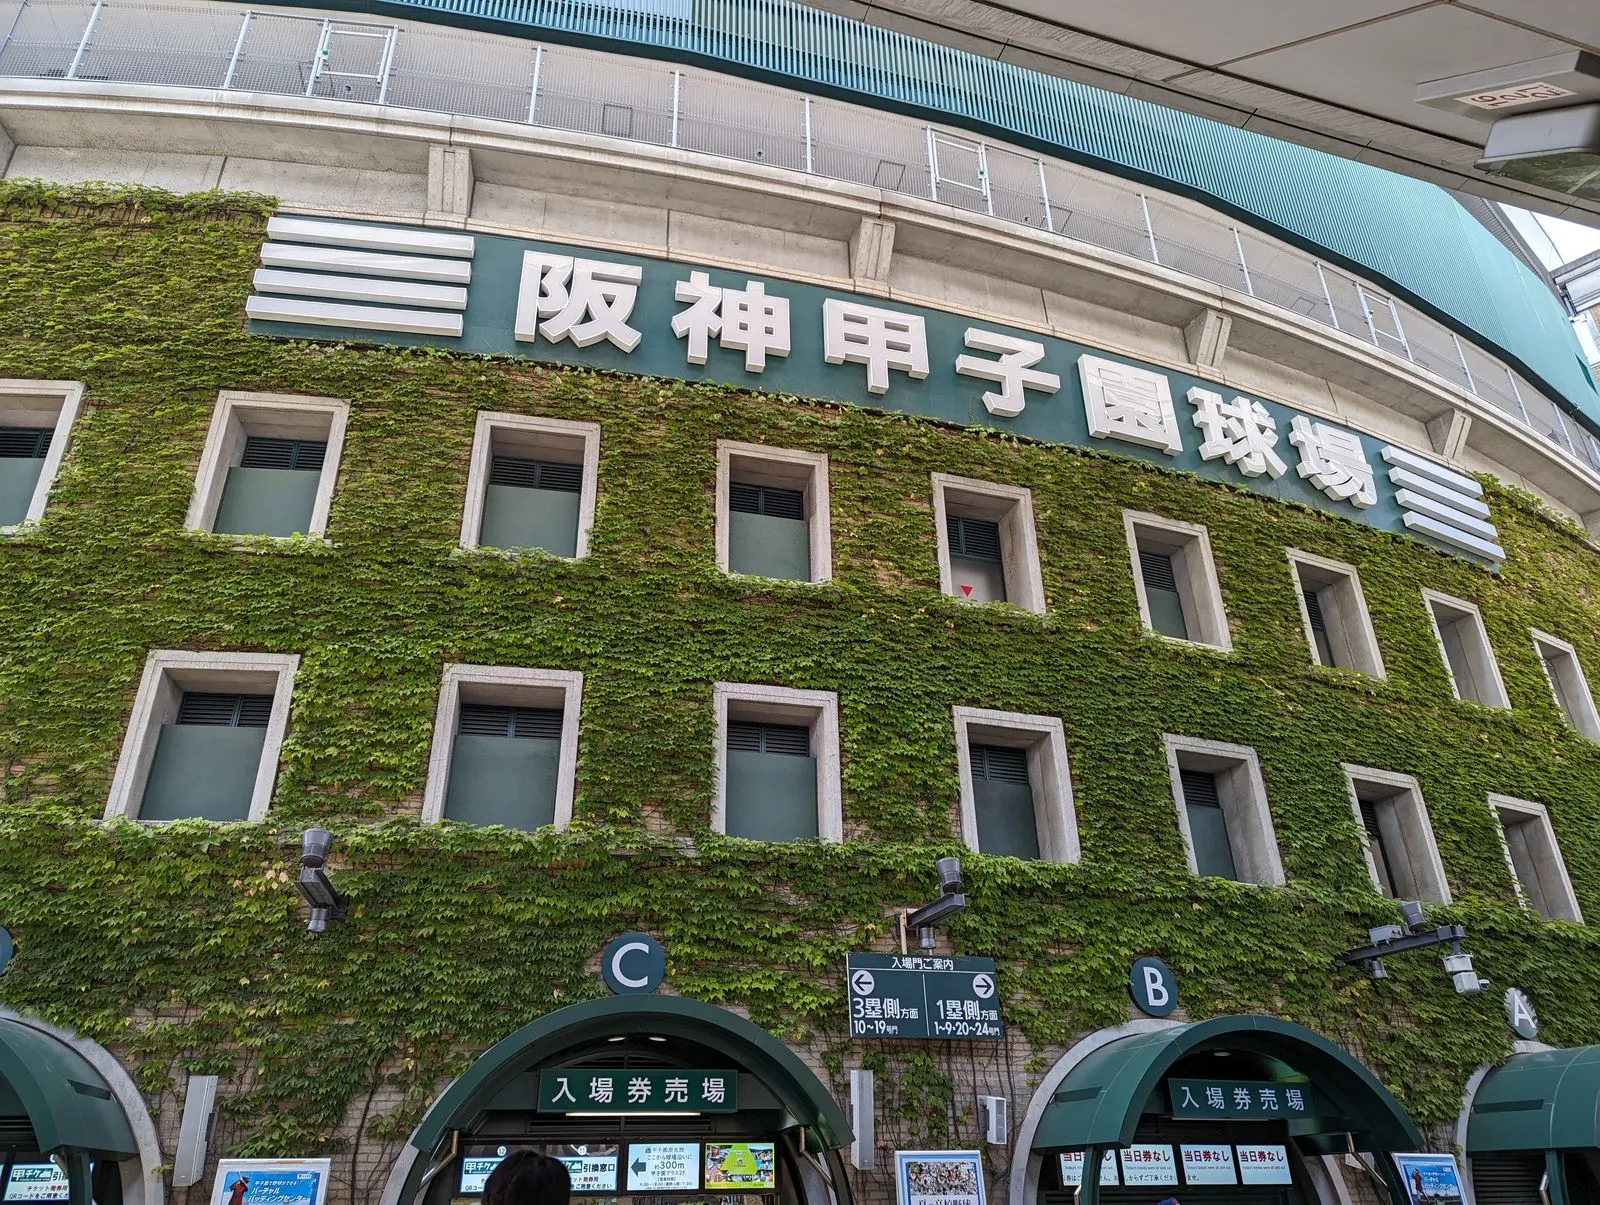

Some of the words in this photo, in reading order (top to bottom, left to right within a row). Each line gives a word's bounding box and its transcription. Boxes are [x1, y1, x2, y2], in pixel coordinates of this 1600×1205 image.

[514, 250, 1377, 510] 阪神甲子園球場
[611, 942, 650, 988] C
[891, 956, 954, 971] 入場門ご案内
[1143, 966, 1169, 1007] B
[1514, 992, 1537, 1029] A
[551, 1076, 726, 1104] 入場券売場
[1181, 1086, 1305, 1111] 入場券売場
[1123, 1150, 1171, 1162] 当日券なし
[1184, 1150, 1230, 1162] 当日券なし
[1239, 1150, 1284, 1162] 当日券なし
[583, 1163, 615, 1173] 引換窓口
[250, 1186, 280, 1195] バーチャル
